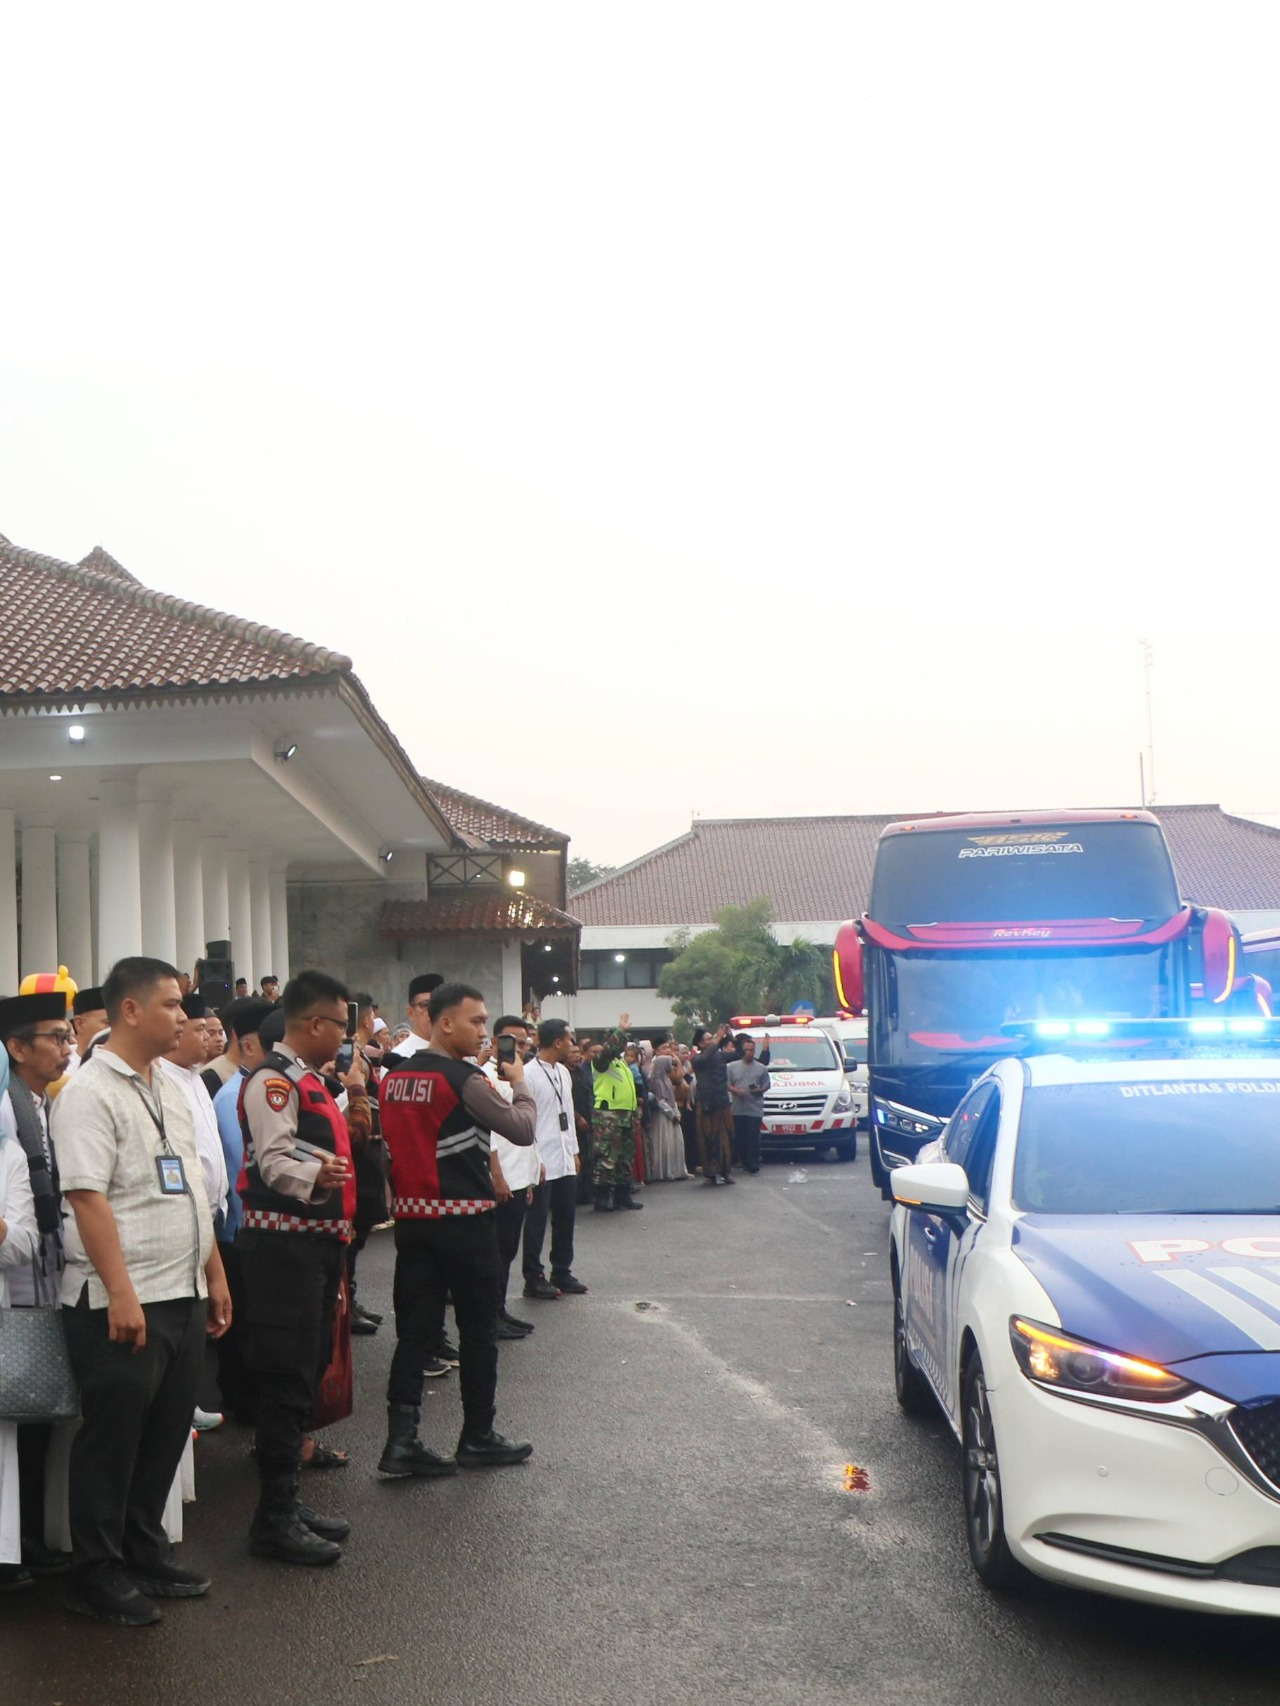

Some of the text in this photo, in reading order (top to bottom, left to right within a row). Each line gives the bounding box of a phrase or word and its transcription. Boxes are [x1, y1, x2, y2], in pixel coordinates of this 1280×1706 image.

[958, 843, 1084, 858] PARIWISATA
[384, 1078, 434, 1103] POLISI
[1120, 1082, 1280, 1098] DITLANTAS POLD
